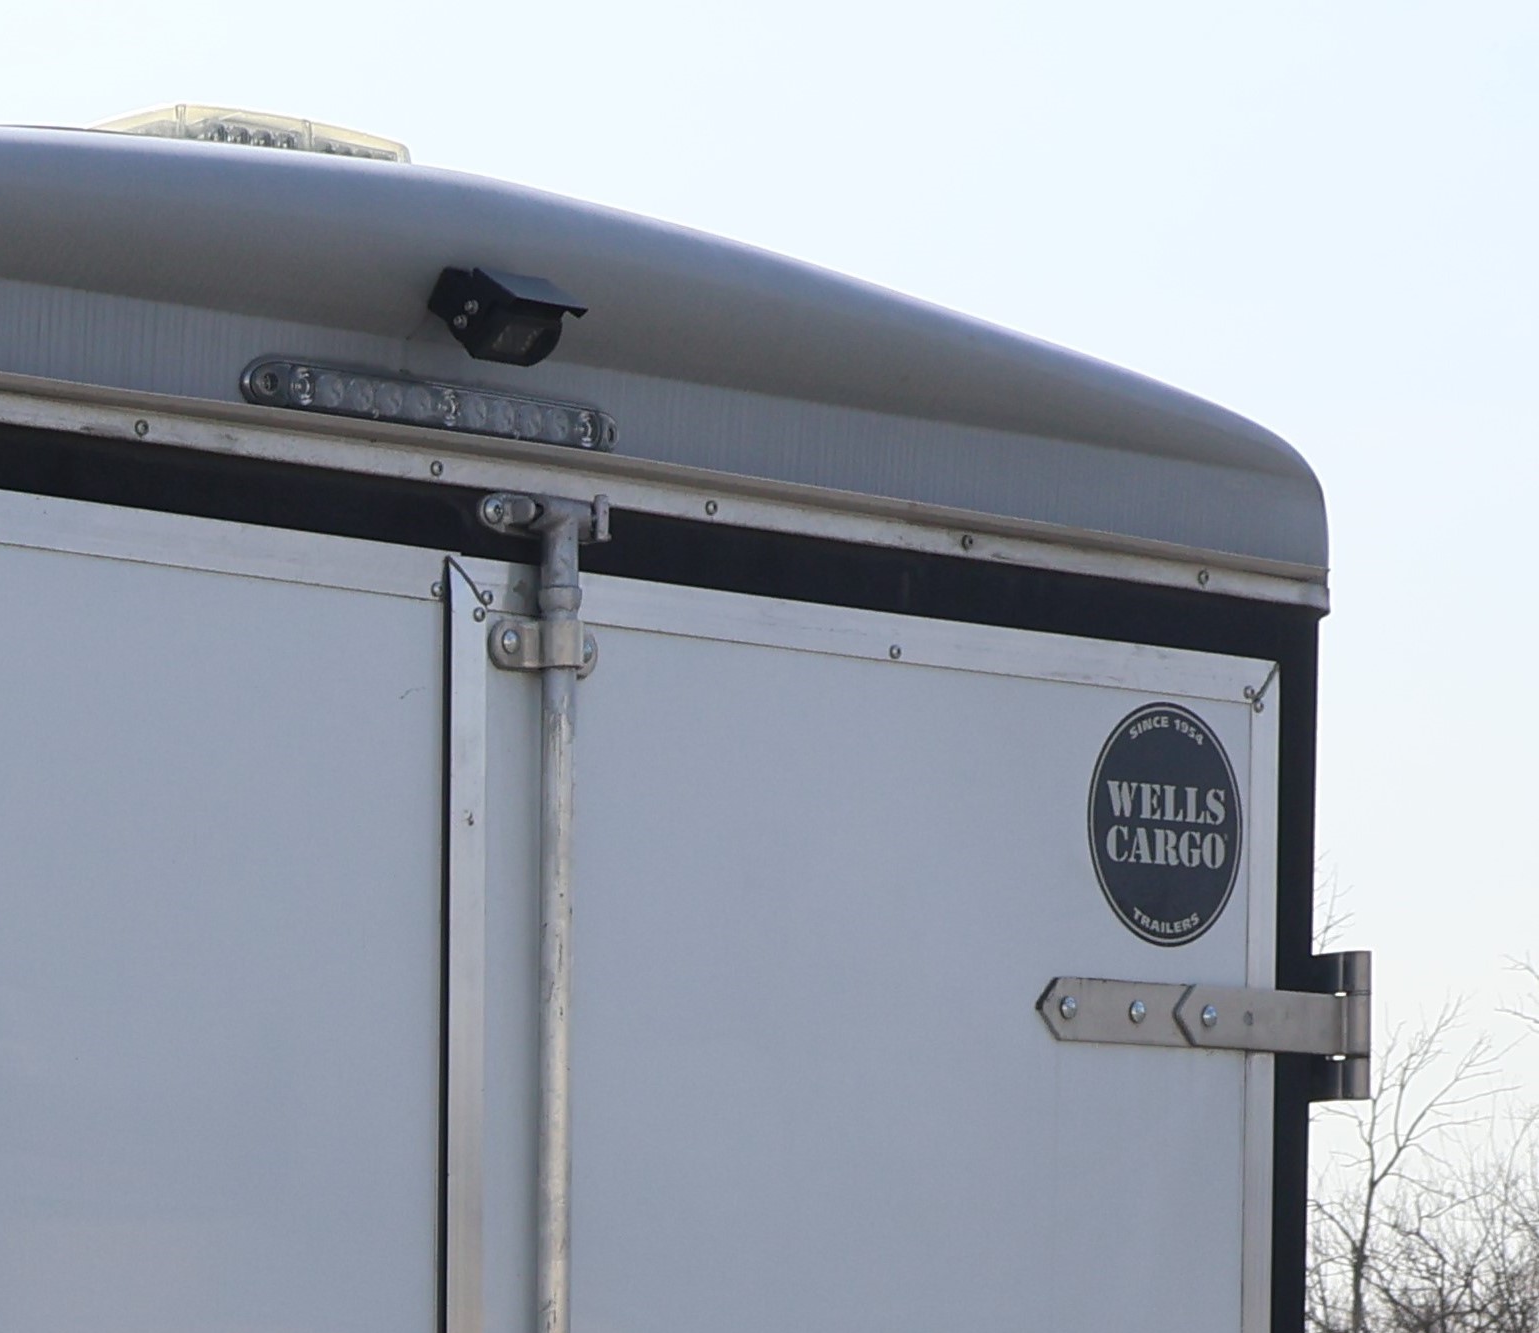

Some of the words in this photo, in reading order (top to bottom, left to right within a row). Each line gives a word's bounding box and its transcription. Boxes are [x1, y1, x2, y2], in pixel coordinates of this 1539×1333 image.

[1129, 715, 1169, 740] SINCE
[1174, 718, 1206, 746] 1954
[1108, 781, 1226, 825] WELLS
[1107, 826, 1225, 869] CARGO
[1132, 906, 1200, 935] TRAILERS
